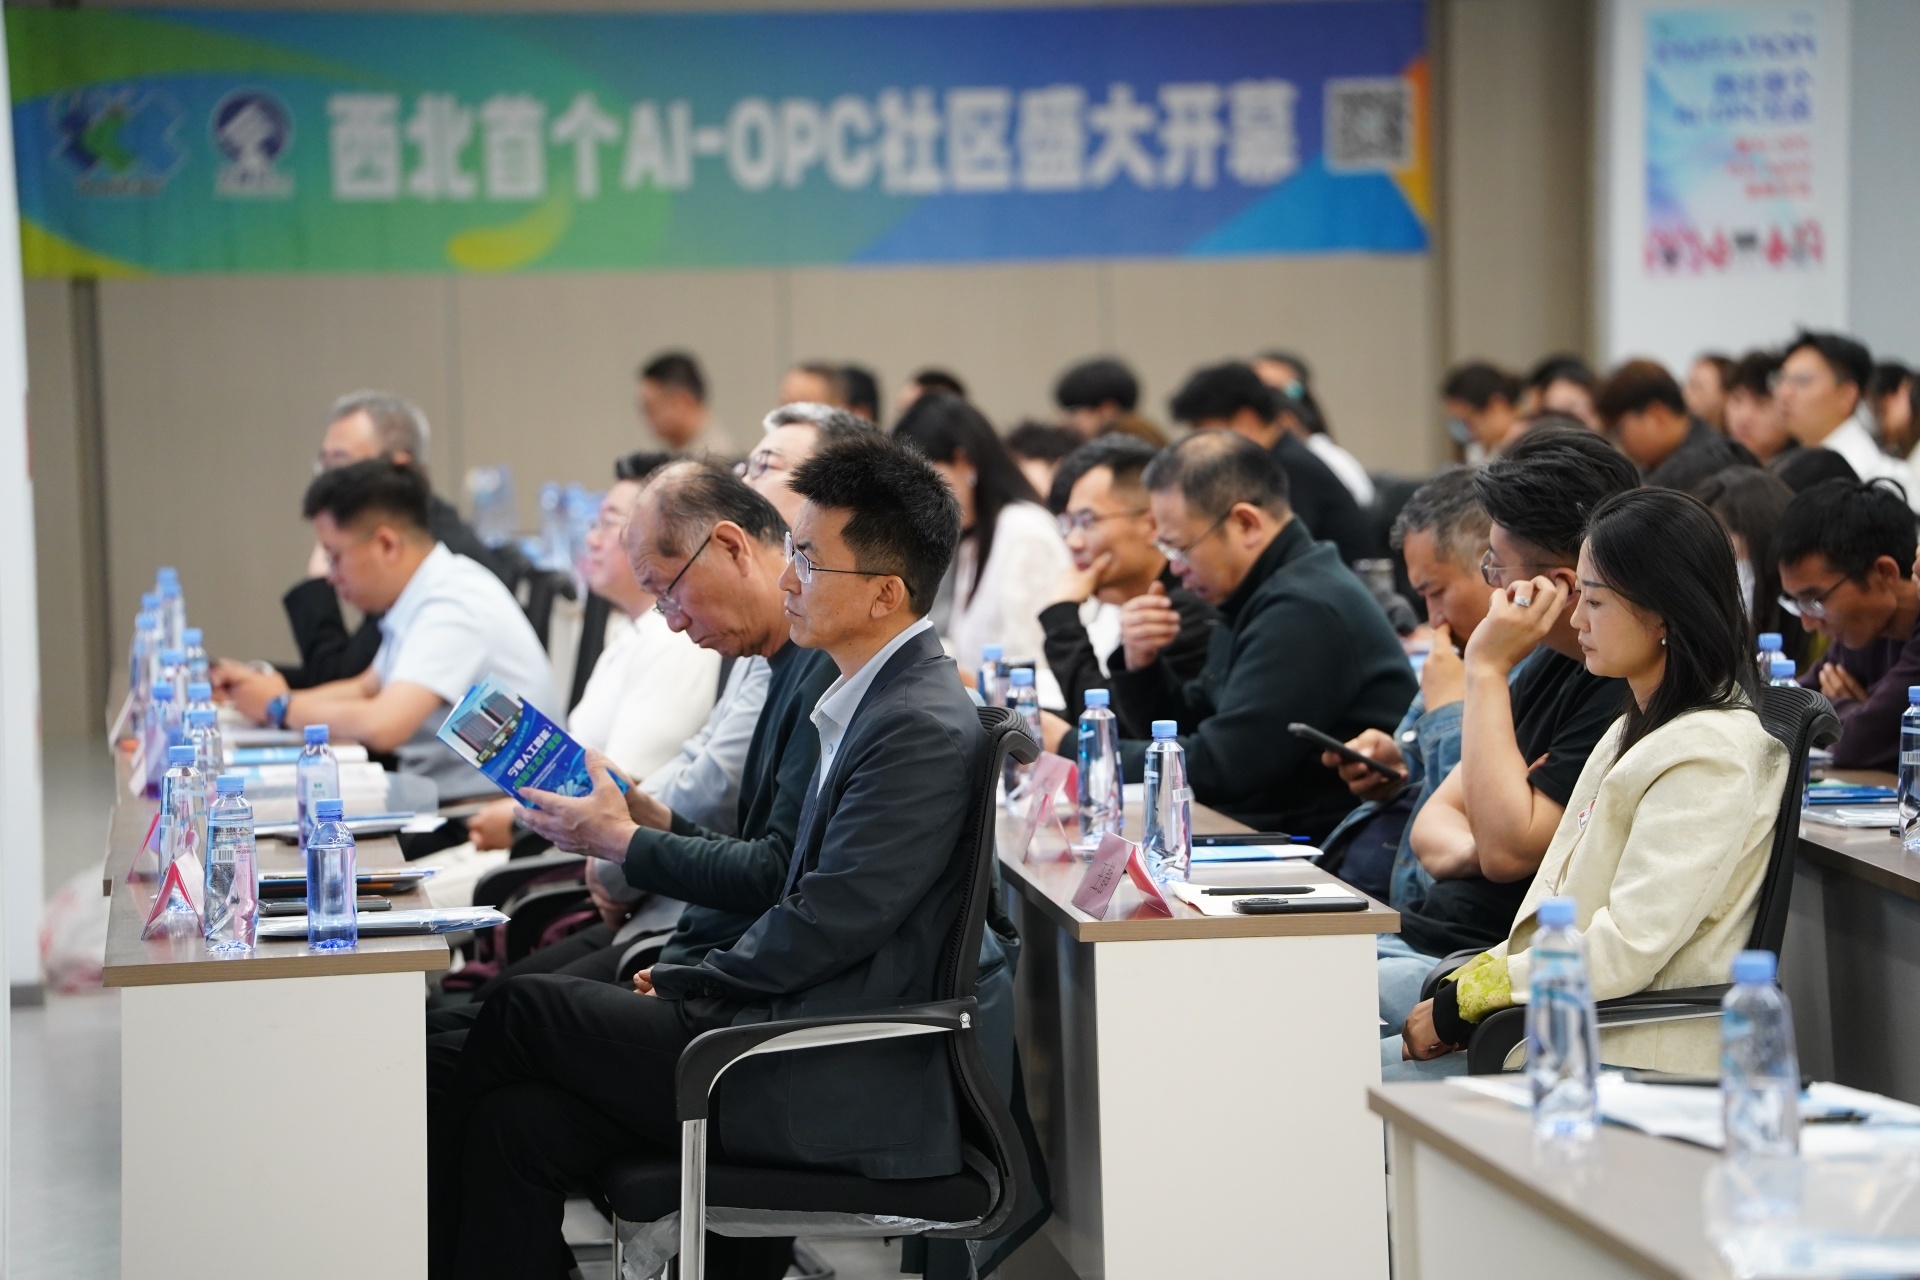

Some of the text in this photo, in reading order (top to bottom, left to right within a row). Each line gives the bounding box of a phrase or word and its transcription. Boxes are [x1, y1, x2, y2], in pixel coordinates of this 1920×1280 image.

[328, 79, 1299, 199] 西北首个AI-OPC社区盛大开幕
